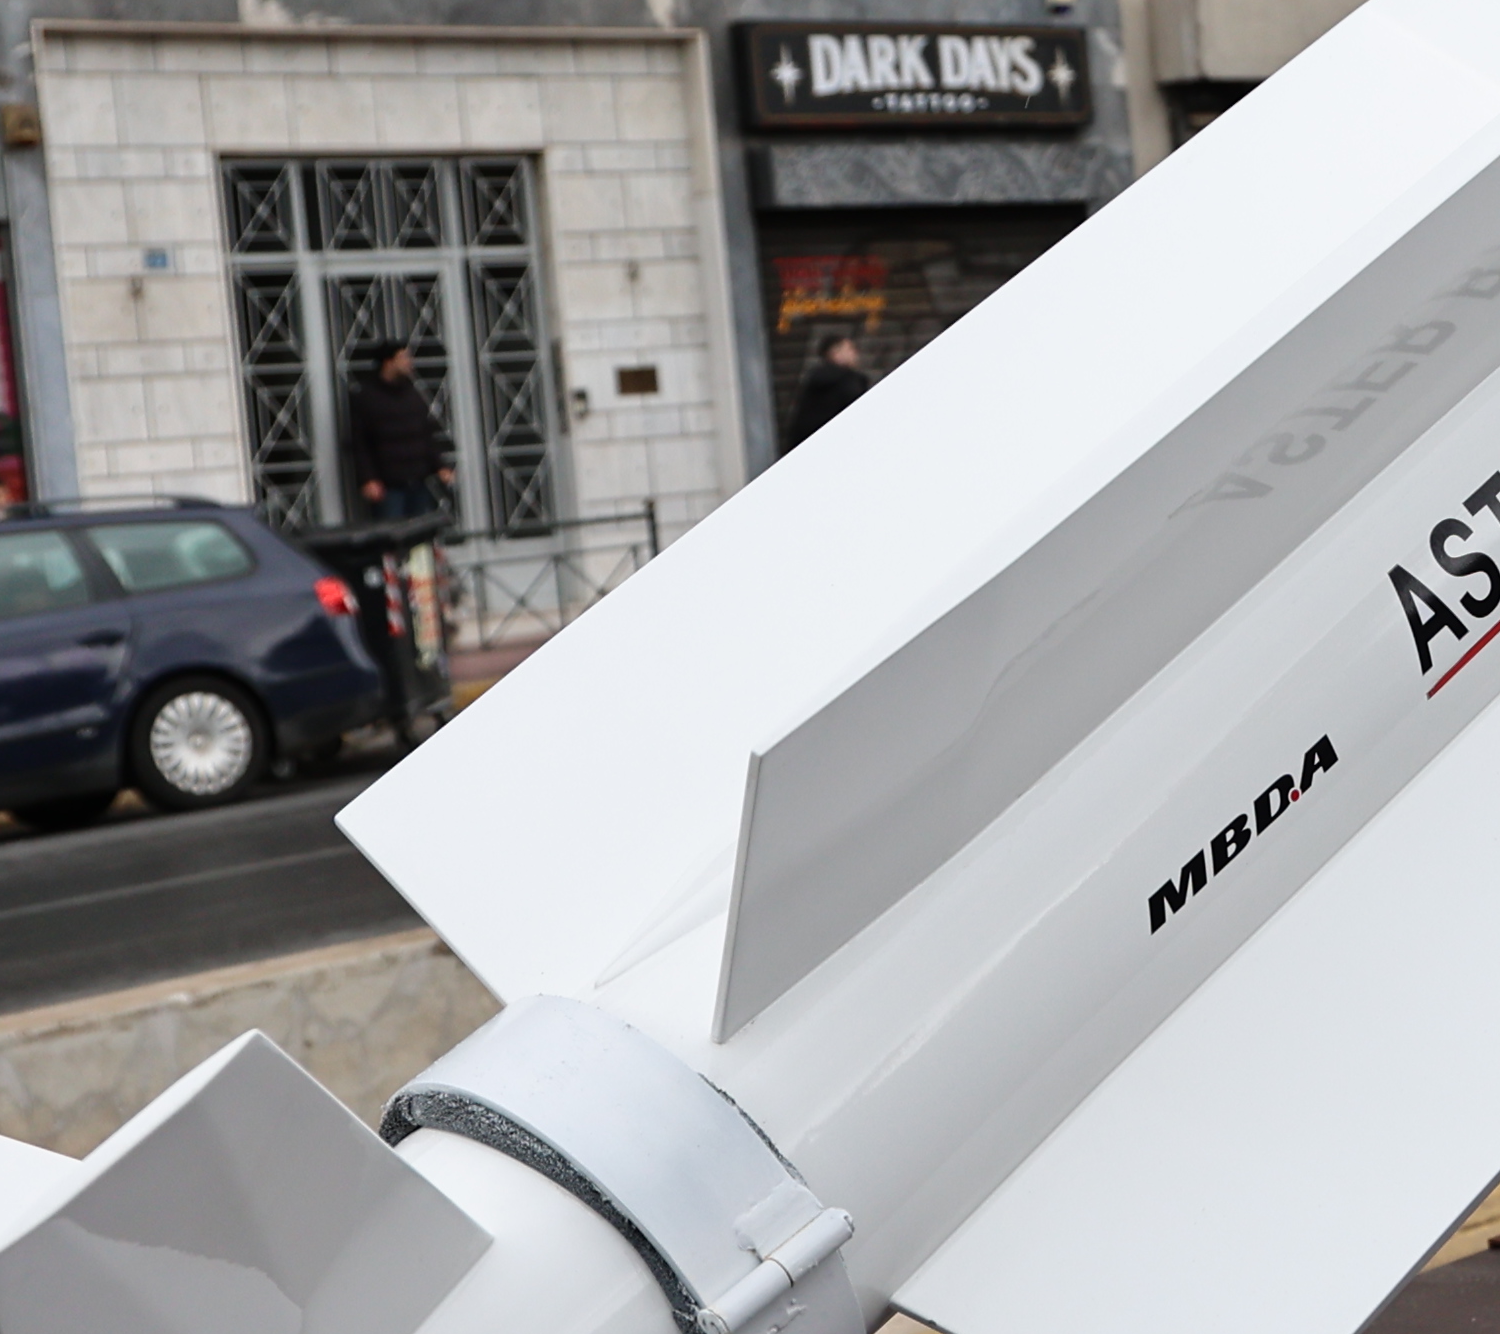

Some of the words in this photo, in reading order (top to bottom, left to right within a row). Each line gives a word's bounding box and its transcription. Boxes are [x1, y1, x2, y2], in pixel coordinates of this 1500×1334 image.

[807, 33, 935, 97] DARK
[936, 33, 1045, 97] DAYS
[884, 92, 977, 115] TATTOO
[1148, 733, 1340, 936] MBDA
